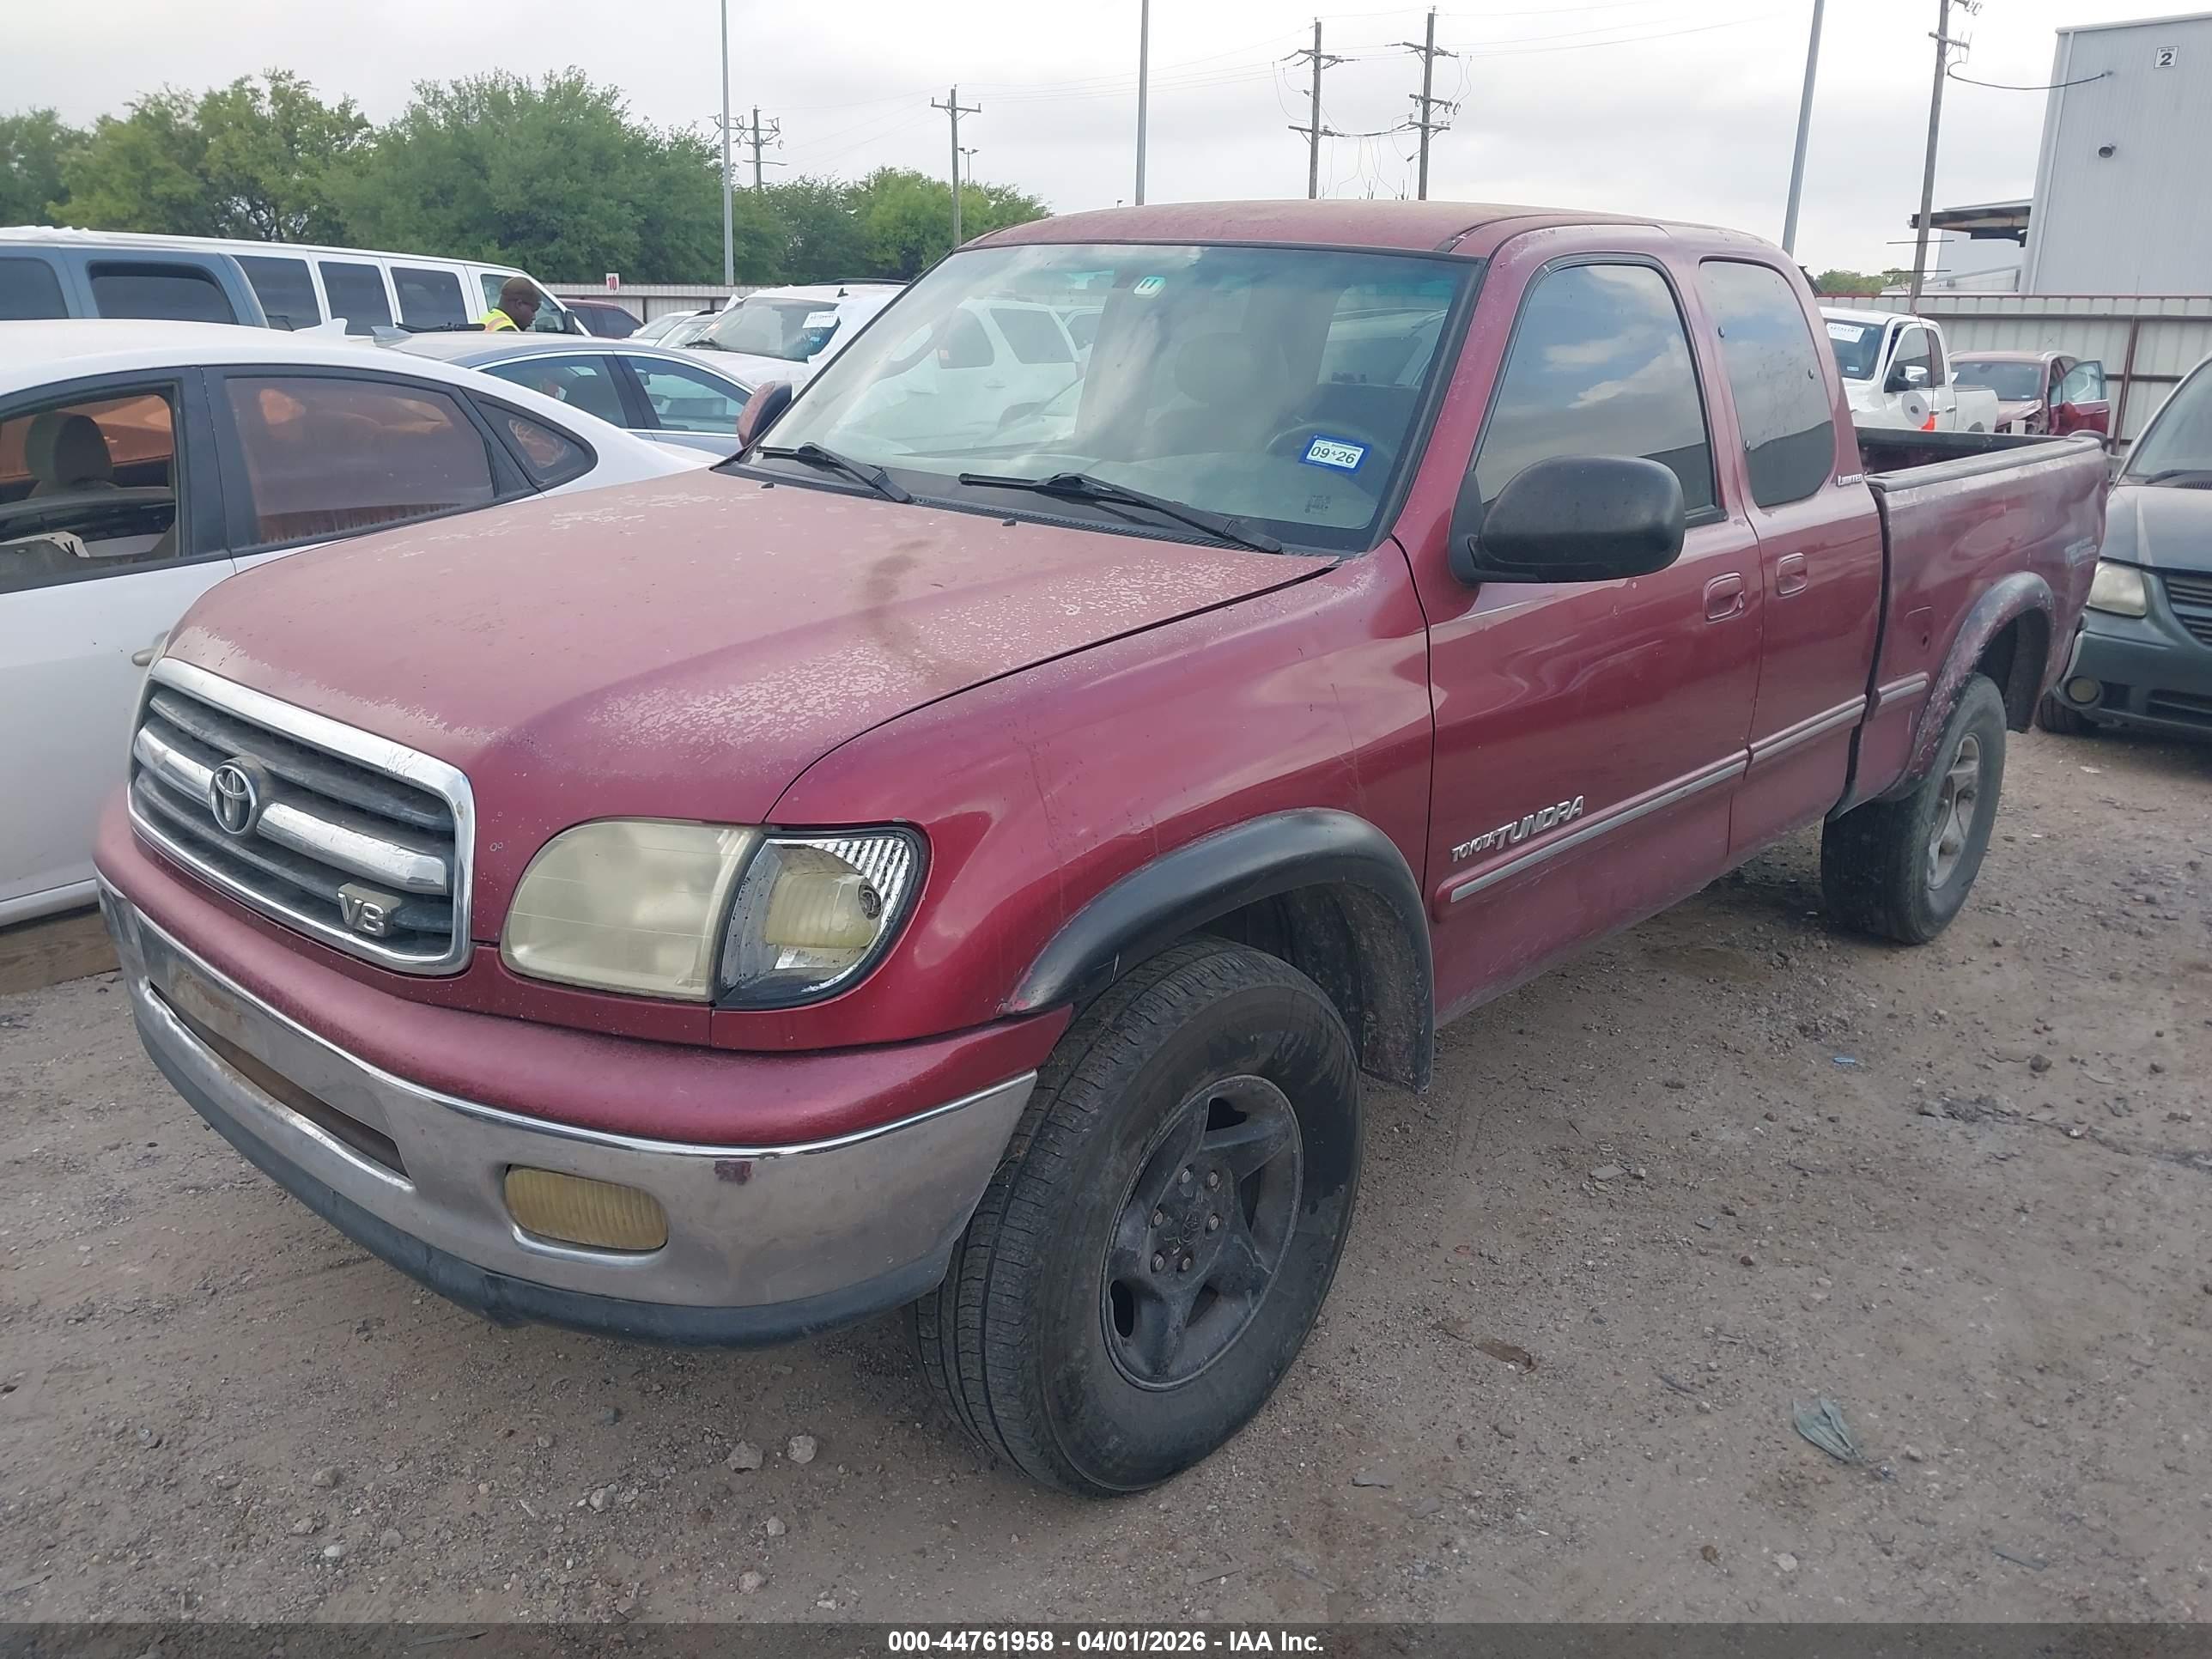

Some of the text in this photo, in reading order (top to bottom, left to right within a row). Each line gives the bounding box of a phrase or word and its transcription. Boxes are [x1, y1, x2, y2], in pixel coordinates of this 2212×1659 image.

[2160, 52, 2172, 66] 2
[608, 276, 617, 290] 10
[1310, 447, 1357, 465] 09 26
[1494, 795, 1584, 850] TUNDRA
[337, 892, 386, 937] V8
